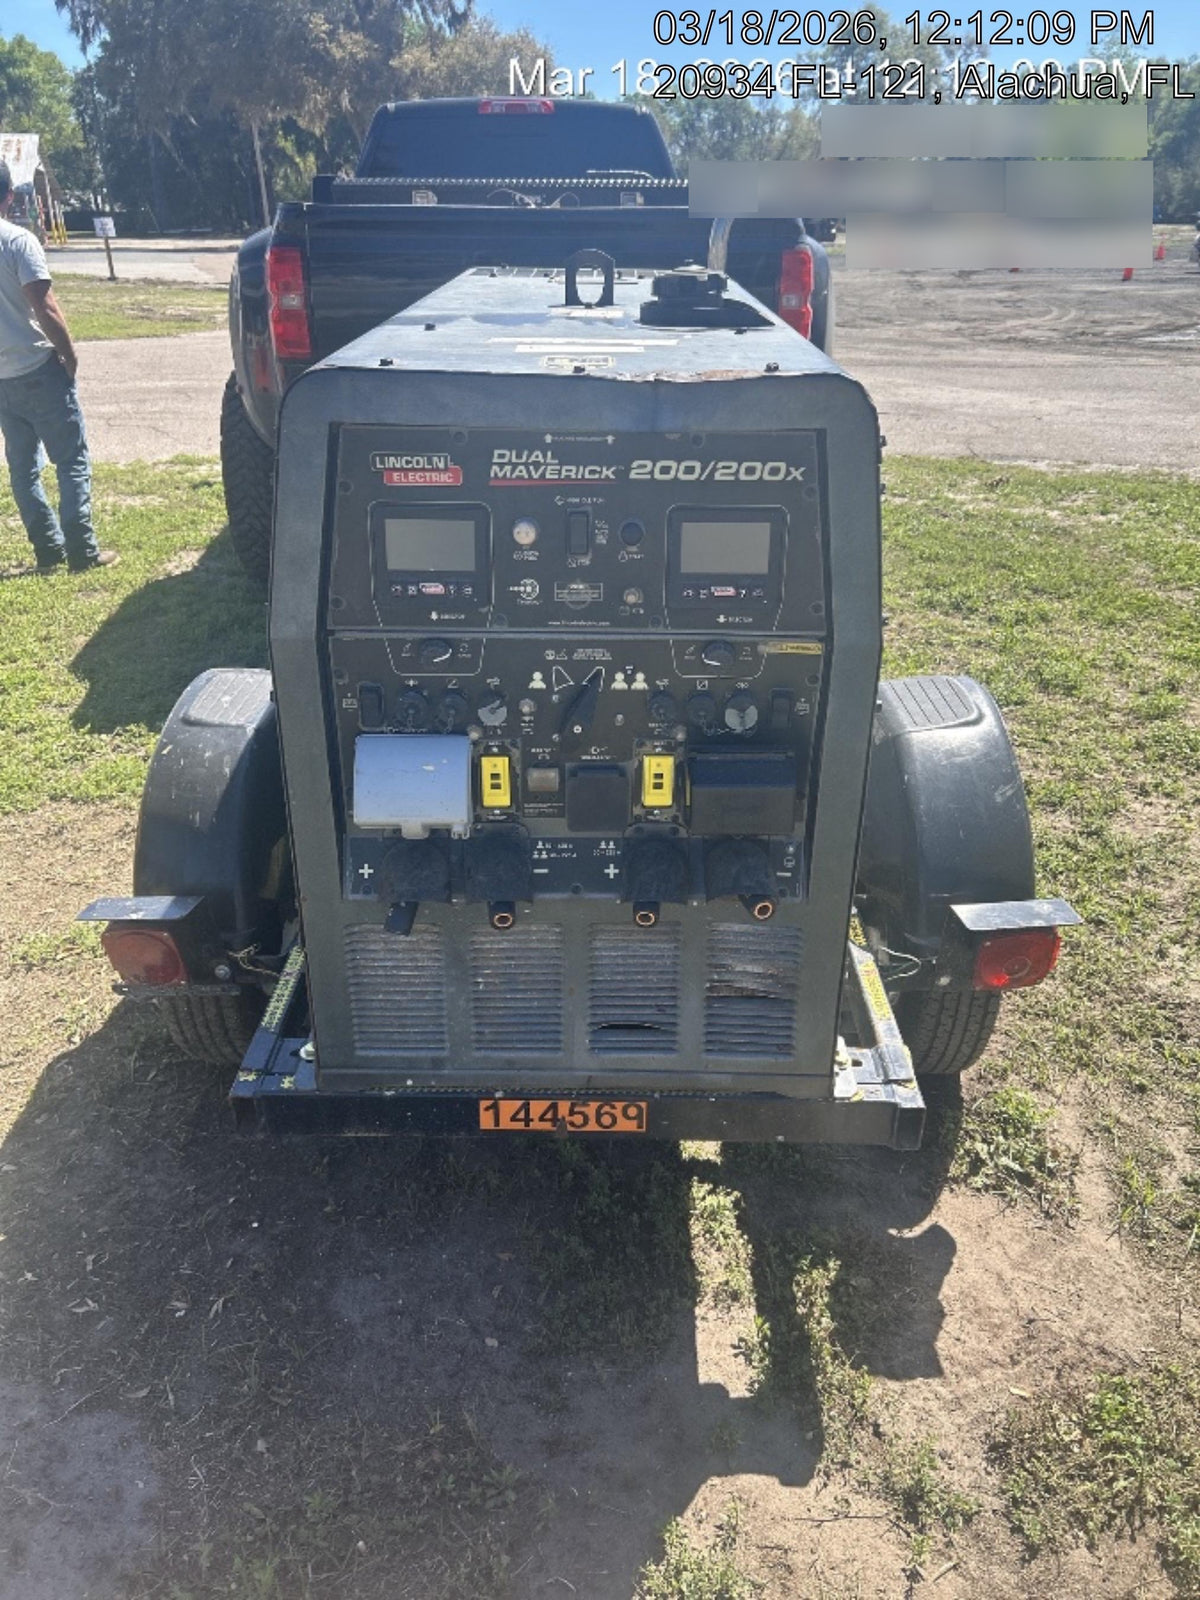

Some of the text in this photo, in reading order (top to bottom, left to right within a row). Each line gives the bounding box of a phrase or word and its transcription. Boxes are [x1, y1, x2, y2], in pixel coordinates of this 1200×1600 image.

[375, 456, 446, 469] LINCOLN
[491, 449, 559, 464] DUAL
[392, 471, 455, 482] ELECTRIC
[629, 459, 807, 481] 200/200x
[482, 1100, 646, 1130] 144569
